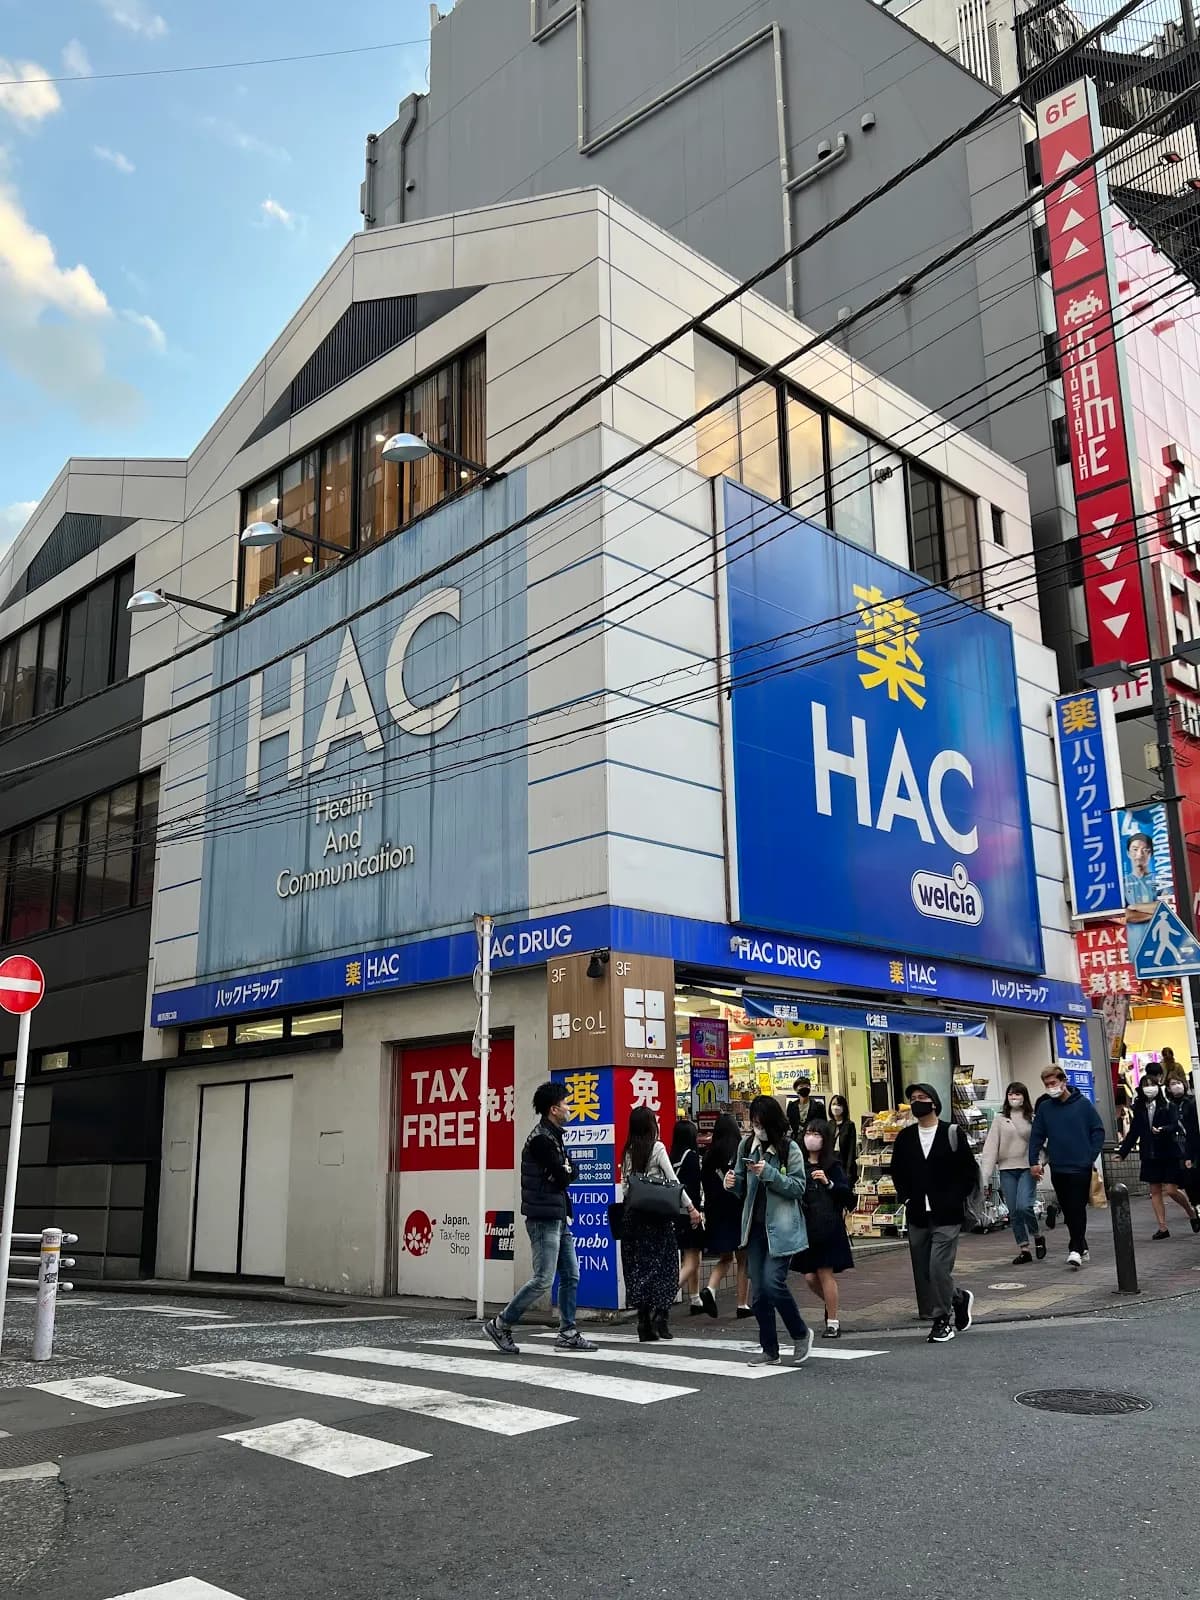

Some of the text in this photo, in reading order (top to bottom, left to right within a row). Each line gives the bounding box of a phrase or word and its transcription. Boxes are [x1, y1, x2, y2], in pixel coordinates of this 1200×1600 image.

[1045, 93, 1077, 124] 6F
[1065, 331, 1089, 481] TAITO STATION
[1076, 322, 1117, 477] GAME
[852, 583, 927, 710] 薬
[245, 587, 461, 796] HAC
[1061, 697, 1098, 735] 薬
[811, 701, 979, 856] HAC
[316, 779, 373, 824] Health
[323, 816, 362, 857] And
[1071, 738, 1114, 910] ハックドラッグ
[1121, 809, 1141, 836] 4
[1150, 804, 1174, 891] YOKOHAMA
[277, 843, 415, 898] Communication
[918, 882, 976, 916] welcia
[478, 925, 573, 961] AC DRUG
[1083, 927, 1127, 947] TAX
[367, 953, 400, 979] HAC
[616, 961, 632, 976] 3F
[738, 941, 821, 970] HAC DRUG
[1081, 948, 1130, 969] FREE
[346, 961, 361, 987] 薬
[551, 967, 567, 983] 3F
[889, 960, 905, 985] 薬
[908, 962, 937, 985] HAC
[214, 978, 284, 1009] ハックドラッグ
[991, 979, 1049, 1004] ハックドラッグ
[1062, 1022, 1083, 1056] 薬
[411, 1067, 469, 1105] TAX
[564, 1072, 600, 1122] 薬
[402, 1111, 476, 1148] FREE
[564, 1128, 610, 1142] ックドラッグ
[442, 1212, 470, 1227] Japan.
[578, 1210, 609, 1226] KOSÉ
[439, 1229, 470, 1241] Tax-free
[450, 1242, 470, 1257] Shop
